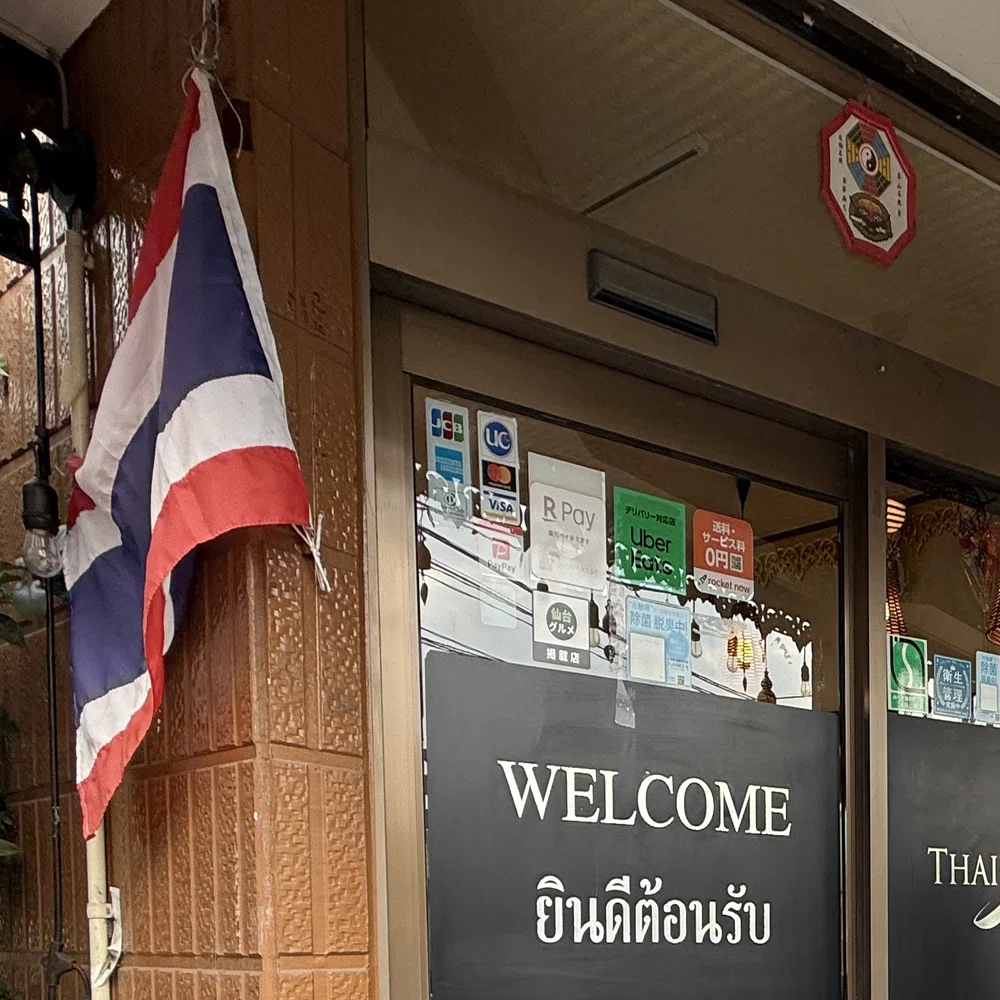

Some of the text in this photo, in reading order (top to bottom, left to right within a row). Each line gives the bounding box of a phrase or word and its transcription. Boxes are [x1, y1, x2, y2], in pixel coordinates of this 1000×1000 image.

[431, 414, 464, 437] JCB
[485, 427, 511, 450] UC
[488, 499, 514, 513] VISA
[561, 501, 596, 531] Pay
[625, 505, 676, 527] デリバリー対応店
[630, 526, 672, 554] Uber
[702, 531, 746, 553] サービス料
[487, 560, 517, 574] PayPay
[630, 548, 673, 576] Eats
[705, 547, 729, 570] 0円
[707, 576, 751, 594] rocket now
[550, 607, 572, 623] 仙台
[549, 621, 576, 635] グルメ
[546, 647, 580, 664] 掲載店
[497, 759, 792, 836] WELCOME
[927, 847, 998, 886] THAI
[536, 875, 771, 944] ยินดีต้อนรับ
